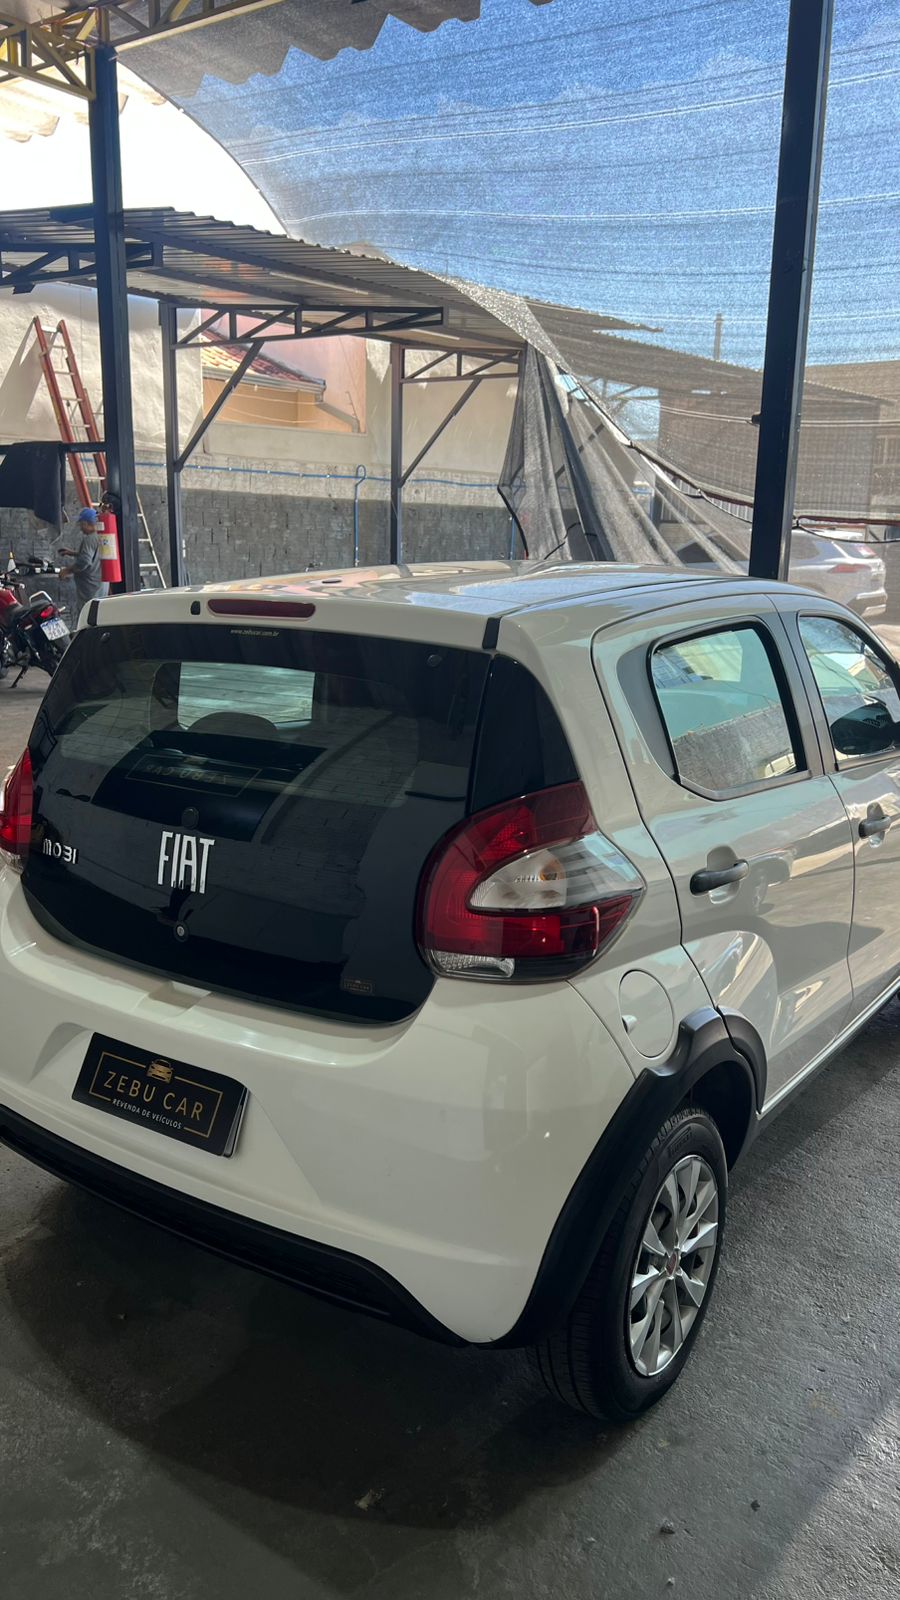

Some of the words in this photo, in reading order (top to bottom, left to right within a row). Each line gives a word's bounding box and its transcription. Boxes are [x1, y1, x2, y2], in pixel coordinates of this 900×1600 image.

[42, 838, 77, 864] MOBI
[157, 831, 215, 894] FIAT
[103, 1071, 156, 1102] ZEBU
[163, 1092, 204, 1121] CAR
[112, 1098, 141, 1114] REVENDA
[142, 1108, 151, 1119] DE
[152, 1112, 182, 1130] VEÍCULOS
